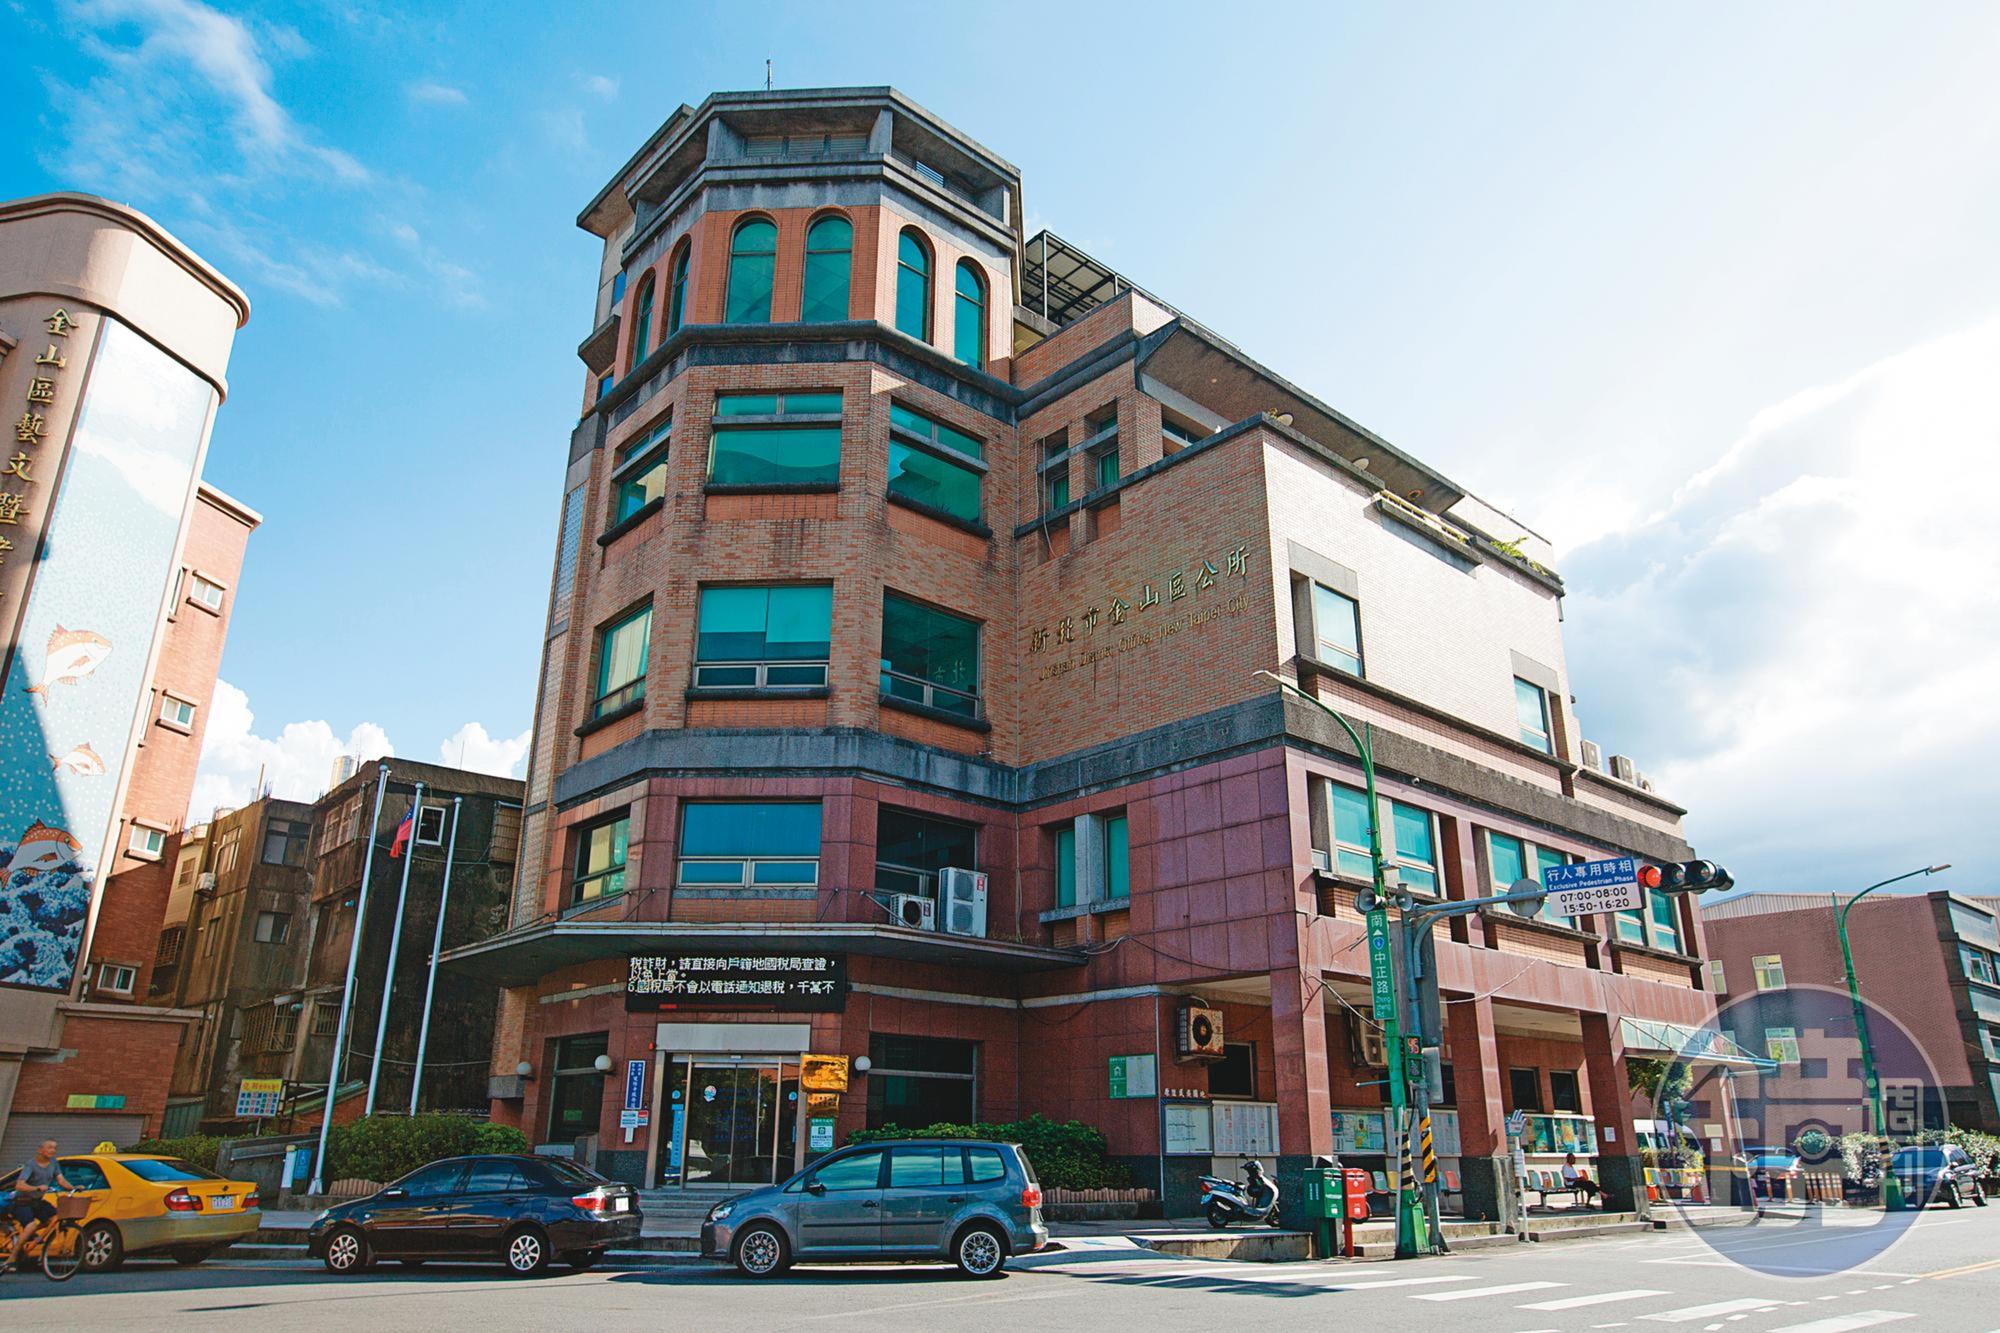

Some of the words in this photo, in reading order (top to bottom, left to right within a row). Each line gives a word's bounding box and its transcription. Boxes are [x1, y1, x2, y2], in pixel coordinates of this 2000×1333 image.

[1029, 545, 1250, 654] 新北市金山區公所
[1160, 620, 1183, 639] New
[1187, 604, 1221, 627] Taipei
[1228, 593, 1249, 614] City
[1547, 859, 1632, 882] 行人專用時相
[1549, 882, 1578, 891] Exclusive
[1580, 878, 1613, 887] Pedestrian
[1560, 886, 1628, 903] 07:00-08:00
[1564, 898, 1630, 914] 15:50-16:20
[1371, 914, 1383, 928] 南
[1374, 951, 1389, 994] 中正路
